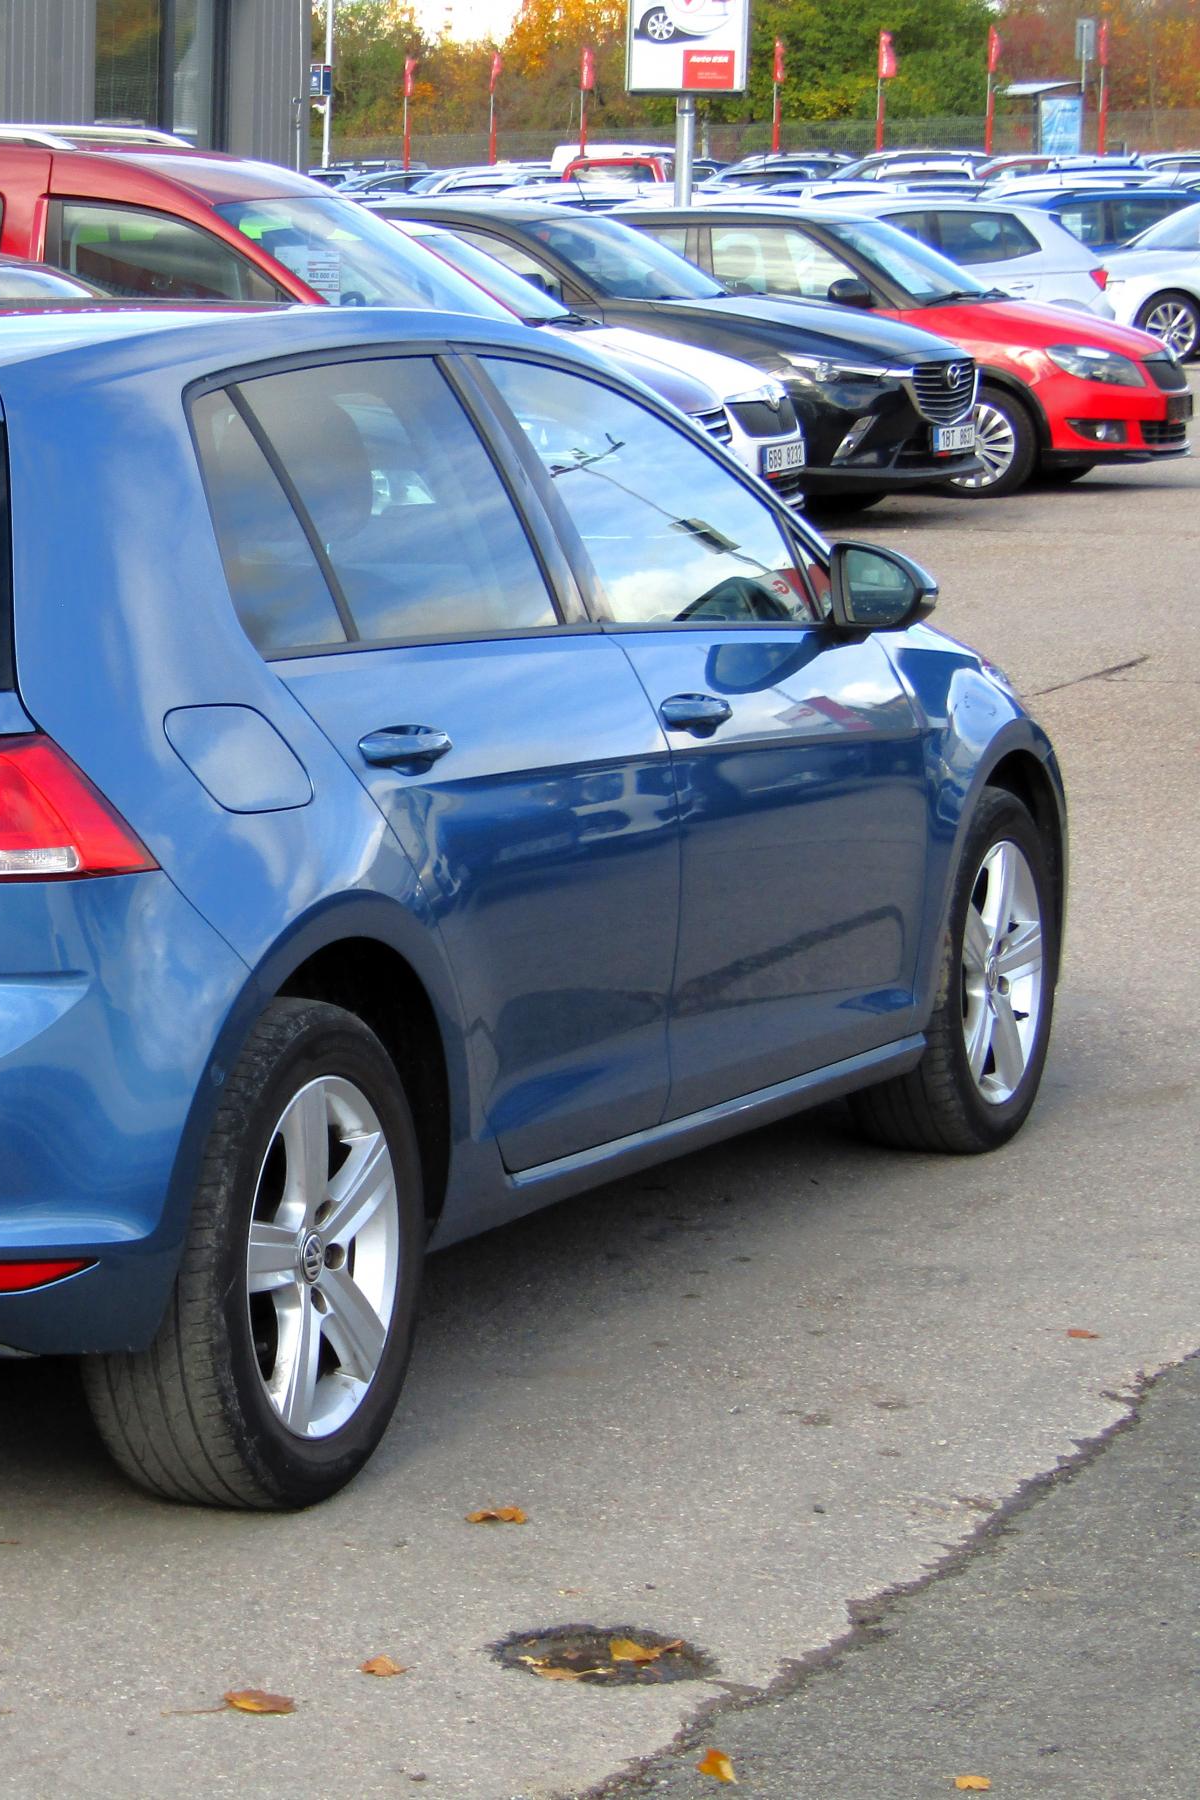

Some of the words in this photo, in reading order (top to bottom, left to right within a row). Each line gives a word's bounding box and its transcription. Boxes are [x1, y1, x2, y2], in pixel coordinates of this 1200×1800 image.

[689, 55, 711, 63] Auto
[942, 429, 956, 448] 1BT
[768, 448, 783, 469] 6B9
